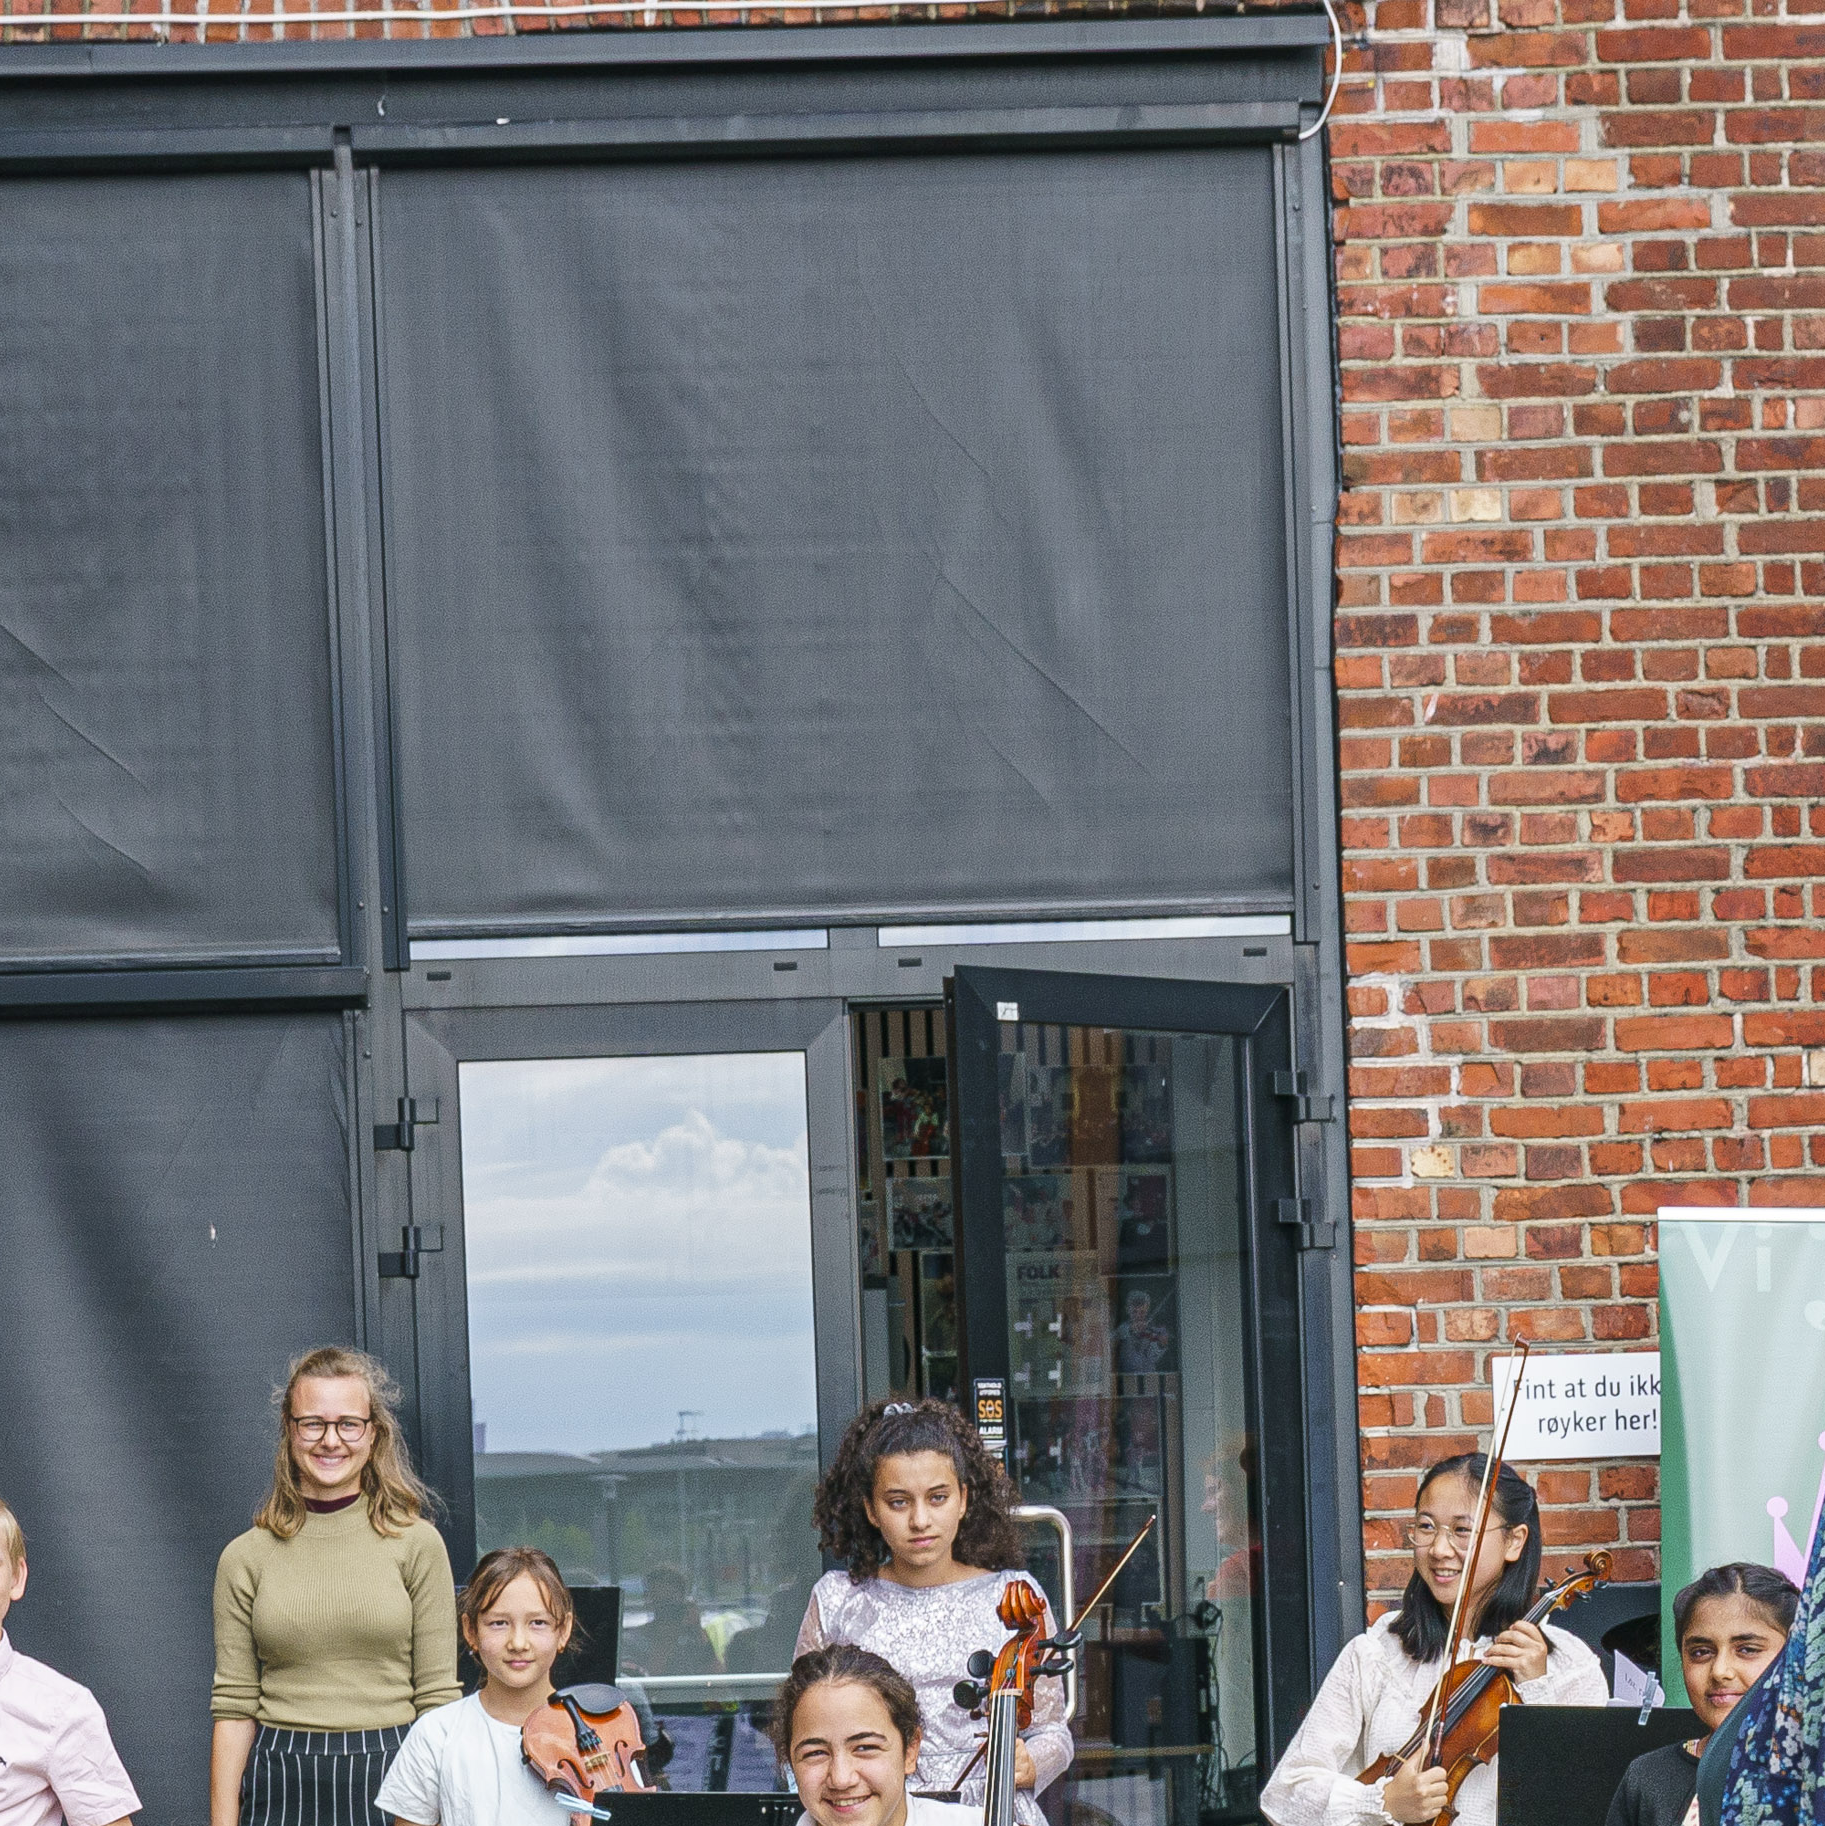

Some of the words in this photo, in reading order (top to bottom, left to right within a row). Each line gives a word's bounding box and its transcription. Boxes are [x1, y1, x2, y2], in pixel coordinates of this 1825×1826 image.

[1564, 1378, 1587, 1398] at
[1594, 1375, 1621, 1398] du
[978, 1399, 1003, 1419] SOS
[1538, 1410, 1607, 1440] røyker
[1615, 1408, 1658, 1431] her!
